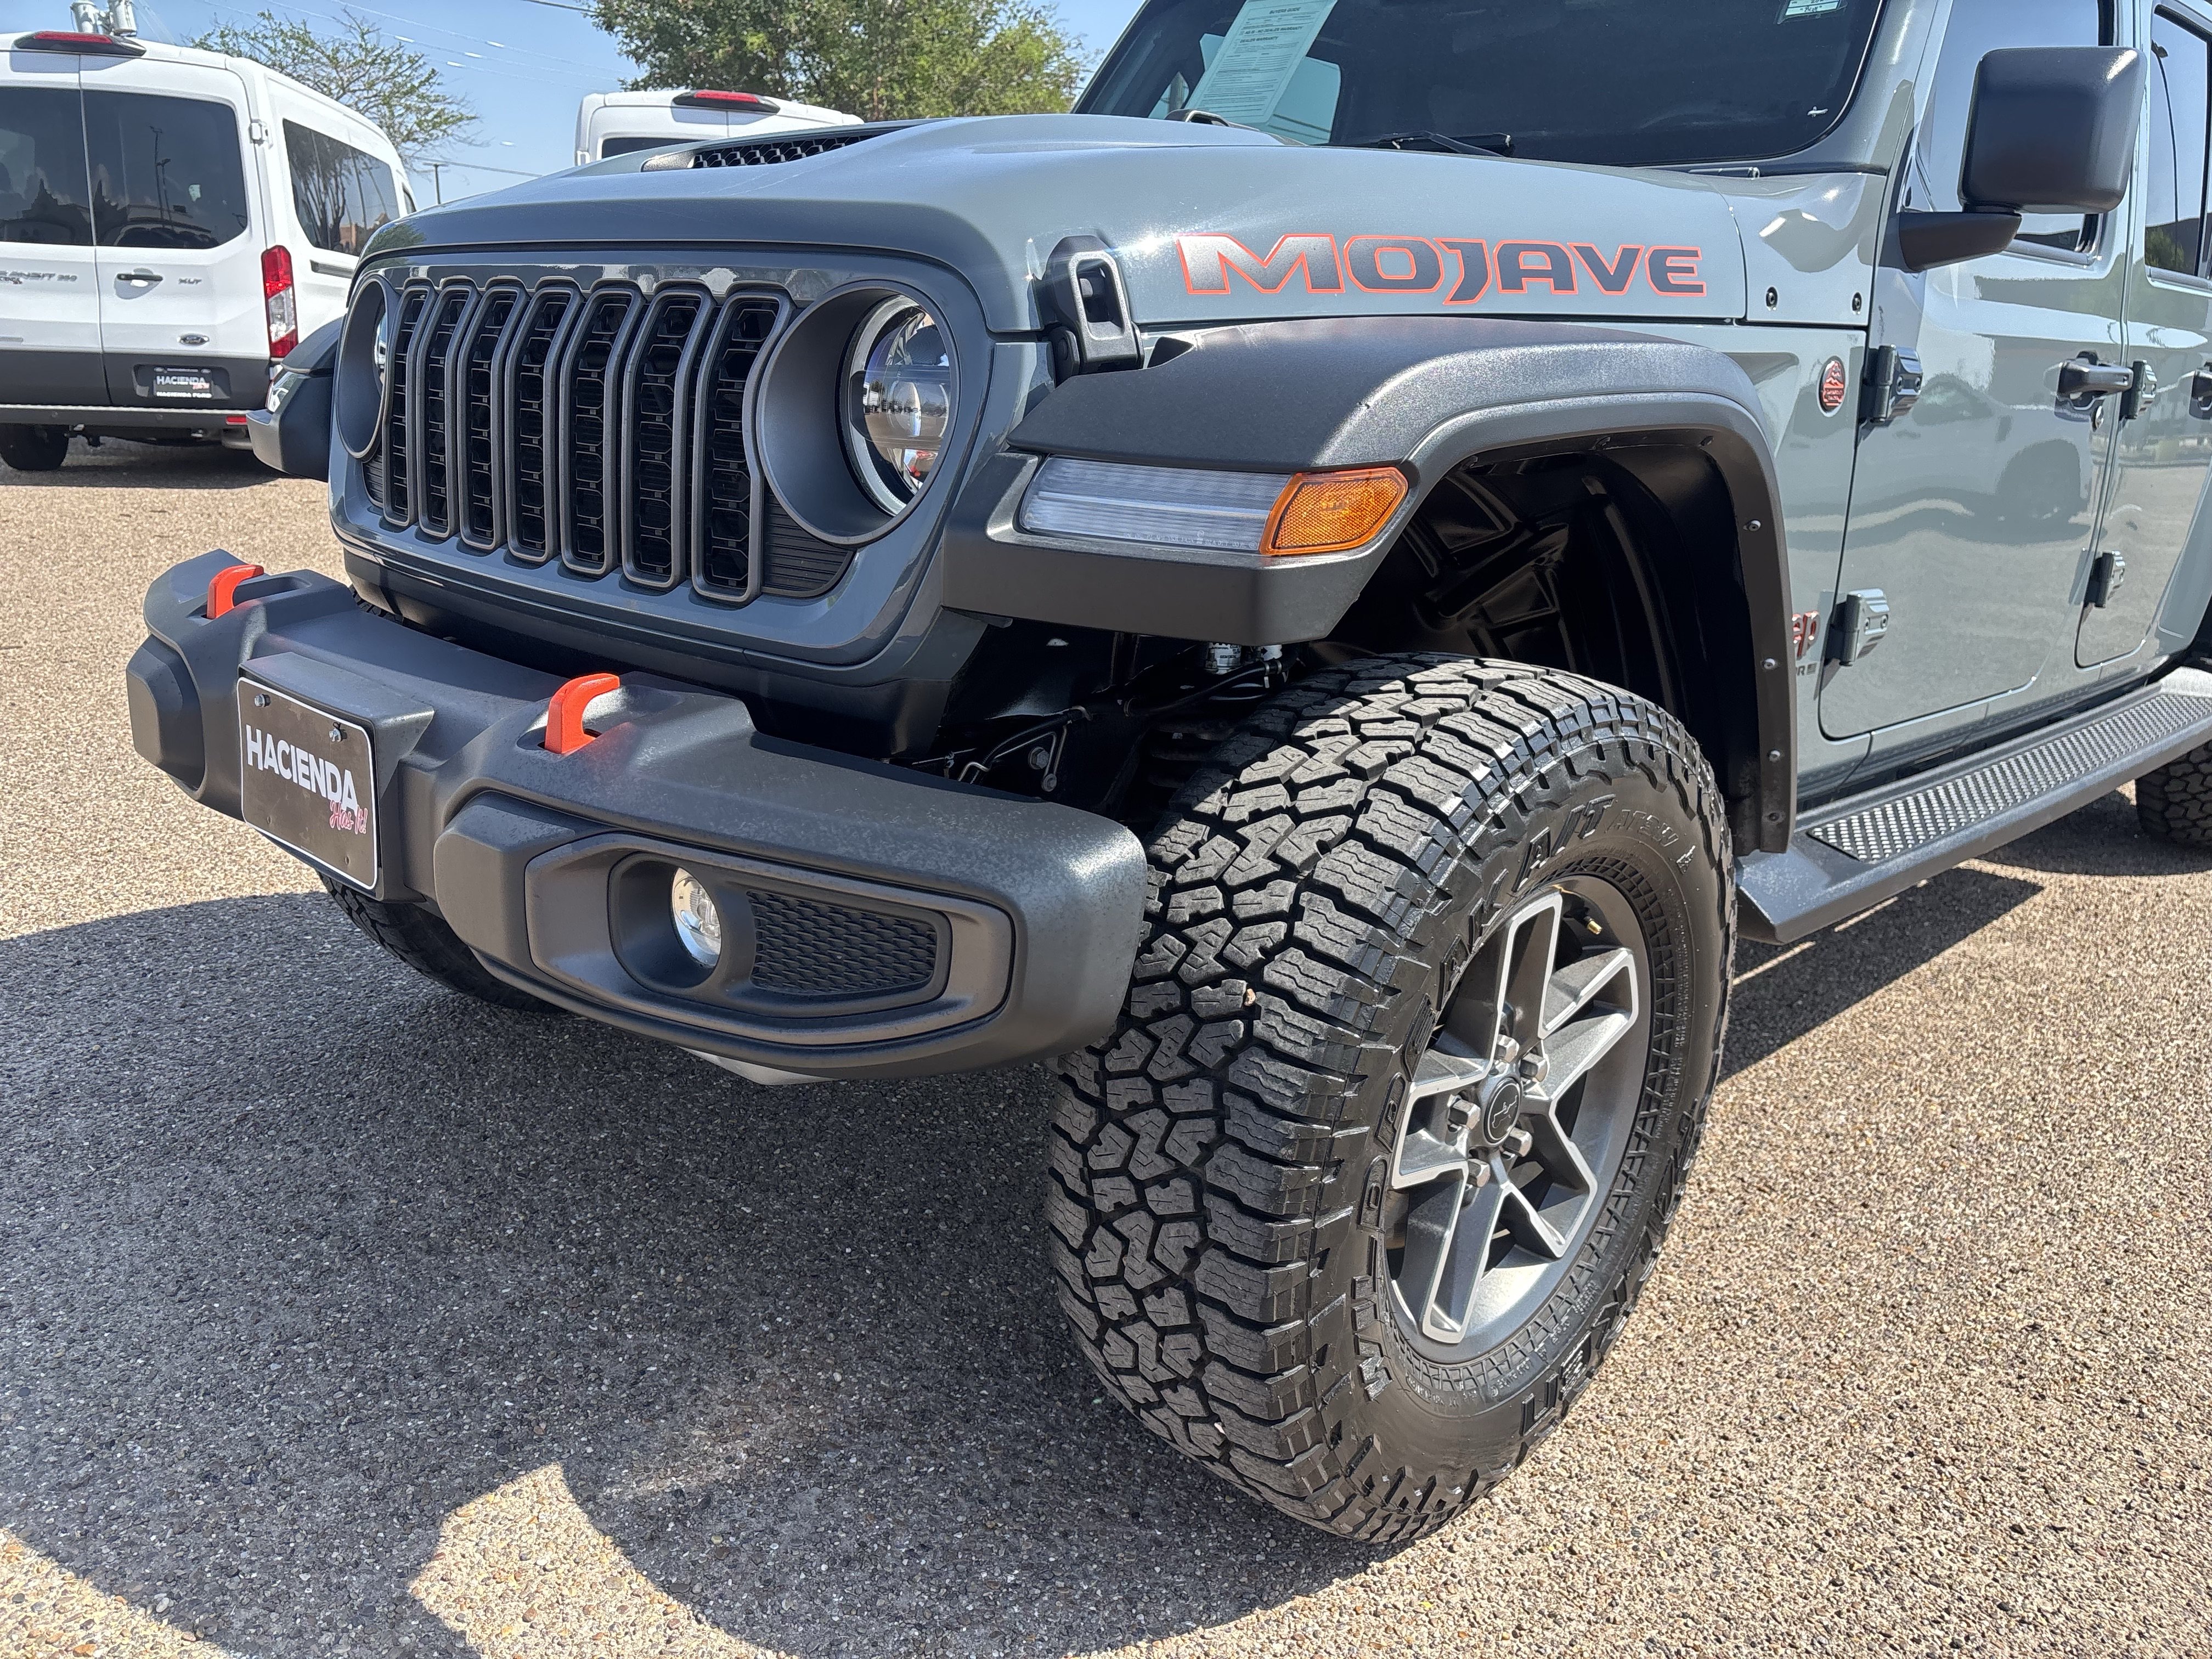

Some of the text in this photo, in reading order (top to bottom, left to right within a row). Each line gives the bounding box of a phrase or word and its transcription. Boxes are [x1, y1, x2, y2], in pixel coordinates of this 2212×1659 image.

[1176, 234, 1707, 305] MOJAVE
[156, 376, 205, 385] HACIENDA
[1792, 611, 1821, 661] ep
[246, 724, 358, 817] HACIENDA
[330, 800, 368, 834] Has It!
[1511, 794, 1616, 892] A/T
